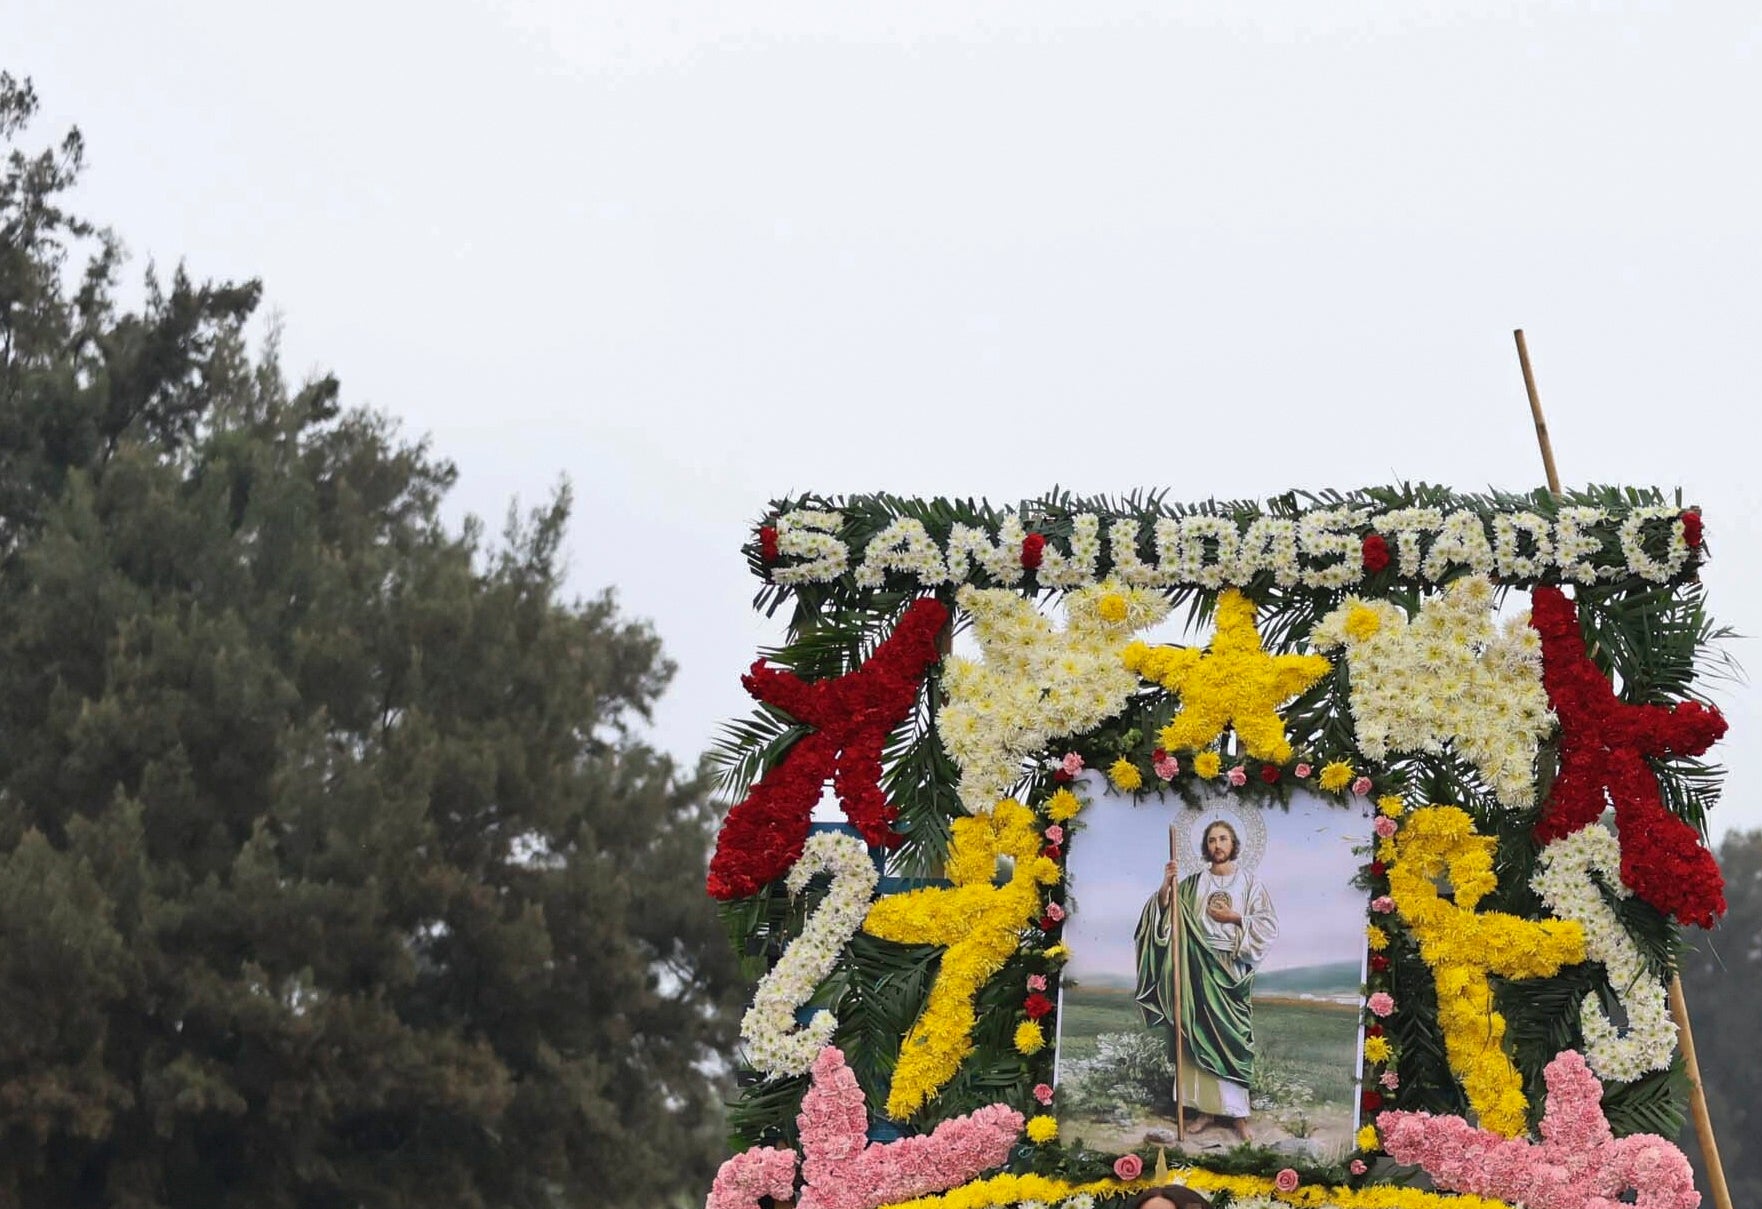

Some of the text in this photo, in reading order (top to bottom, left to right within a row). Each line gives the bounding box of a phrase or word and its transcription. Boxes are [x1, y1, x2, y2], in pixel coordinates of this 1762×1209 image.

[771, 504, 1690, 590] SAN JUDAS TADEO
